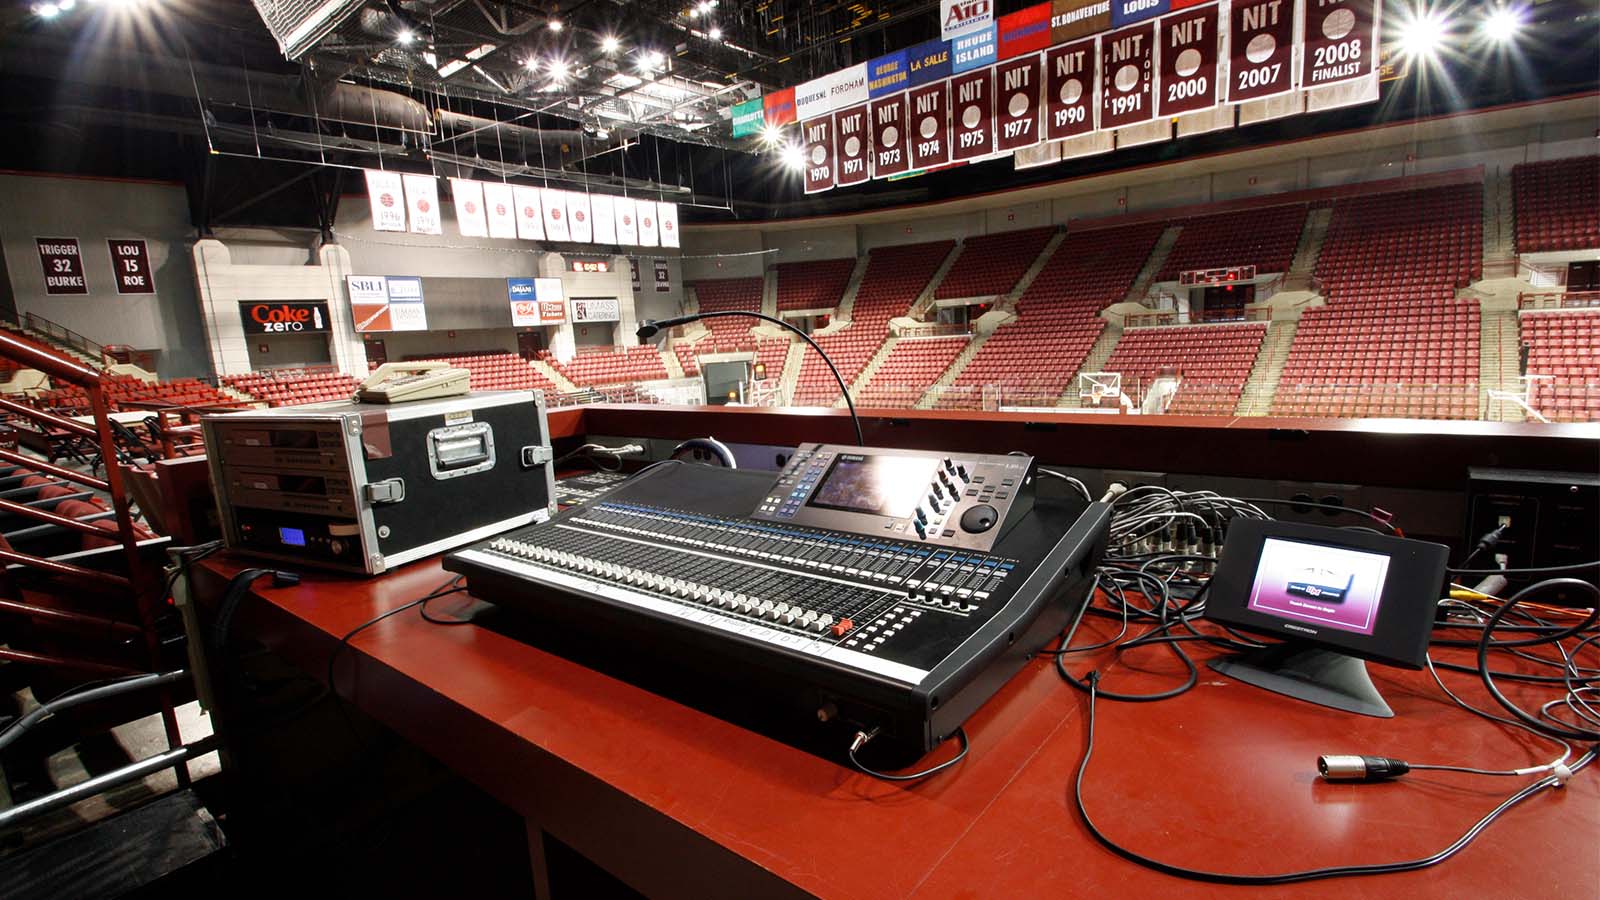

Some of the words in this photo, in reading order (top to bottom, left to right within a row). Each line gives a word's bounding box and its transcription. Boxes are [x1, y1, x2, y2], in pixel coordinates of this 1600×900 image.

[1242, 1, 1282, 32] NIT
[1172, 17, 1206, 48] NIT
[956, 44, 994, 64] ISLAND
[1112, 34, 1143, 62] NIT
[1314, 39, 1361, 68] 2008
[910, 62, 921, 72] LA
[924, 51, 948, 67] SALLE
[1056, 51, 1085, 77] NIT
[1312, 62, 1360, 81] FINALIST
[1005, 65, 1031, 91] NIT
[1238, 63, 1282, 90] 2007
[831, 78, 864, 96] FORDHAM
[960, 78, 984, 103] NIT
[1168, 76, 1207, 102] 2000
[878, 102, 900, 124] NIT
[916, 92, 939, 114] NIT
[1112, 93, 1141, 116] 1991
[842, 114, 862, 135] NIT
[1055, 105, 1085, 128] 1990
[809, 124, 826, 142] NIT
[1004, 118, 1032, 138] 1977
[960, 129, 984, 148] 1975
[879, 148, 900, 166] 1973
[918, 140, 940, 158] 1974
[810, 166, 830, 182] 1970
[844, 158, 863, 174] 1971
[40, 244, 78, 255] TRIGGER
[118, 246, 140, 256] LOU
[53, 259, 72, 272] 32
[124, 260, 138, 272] 15
[48, 276, 84, 287] BURKE
[124, 276, 144, 286] ROE
[251, 304, 309, 323] Coke
[264, 322, 303, 332] zero
